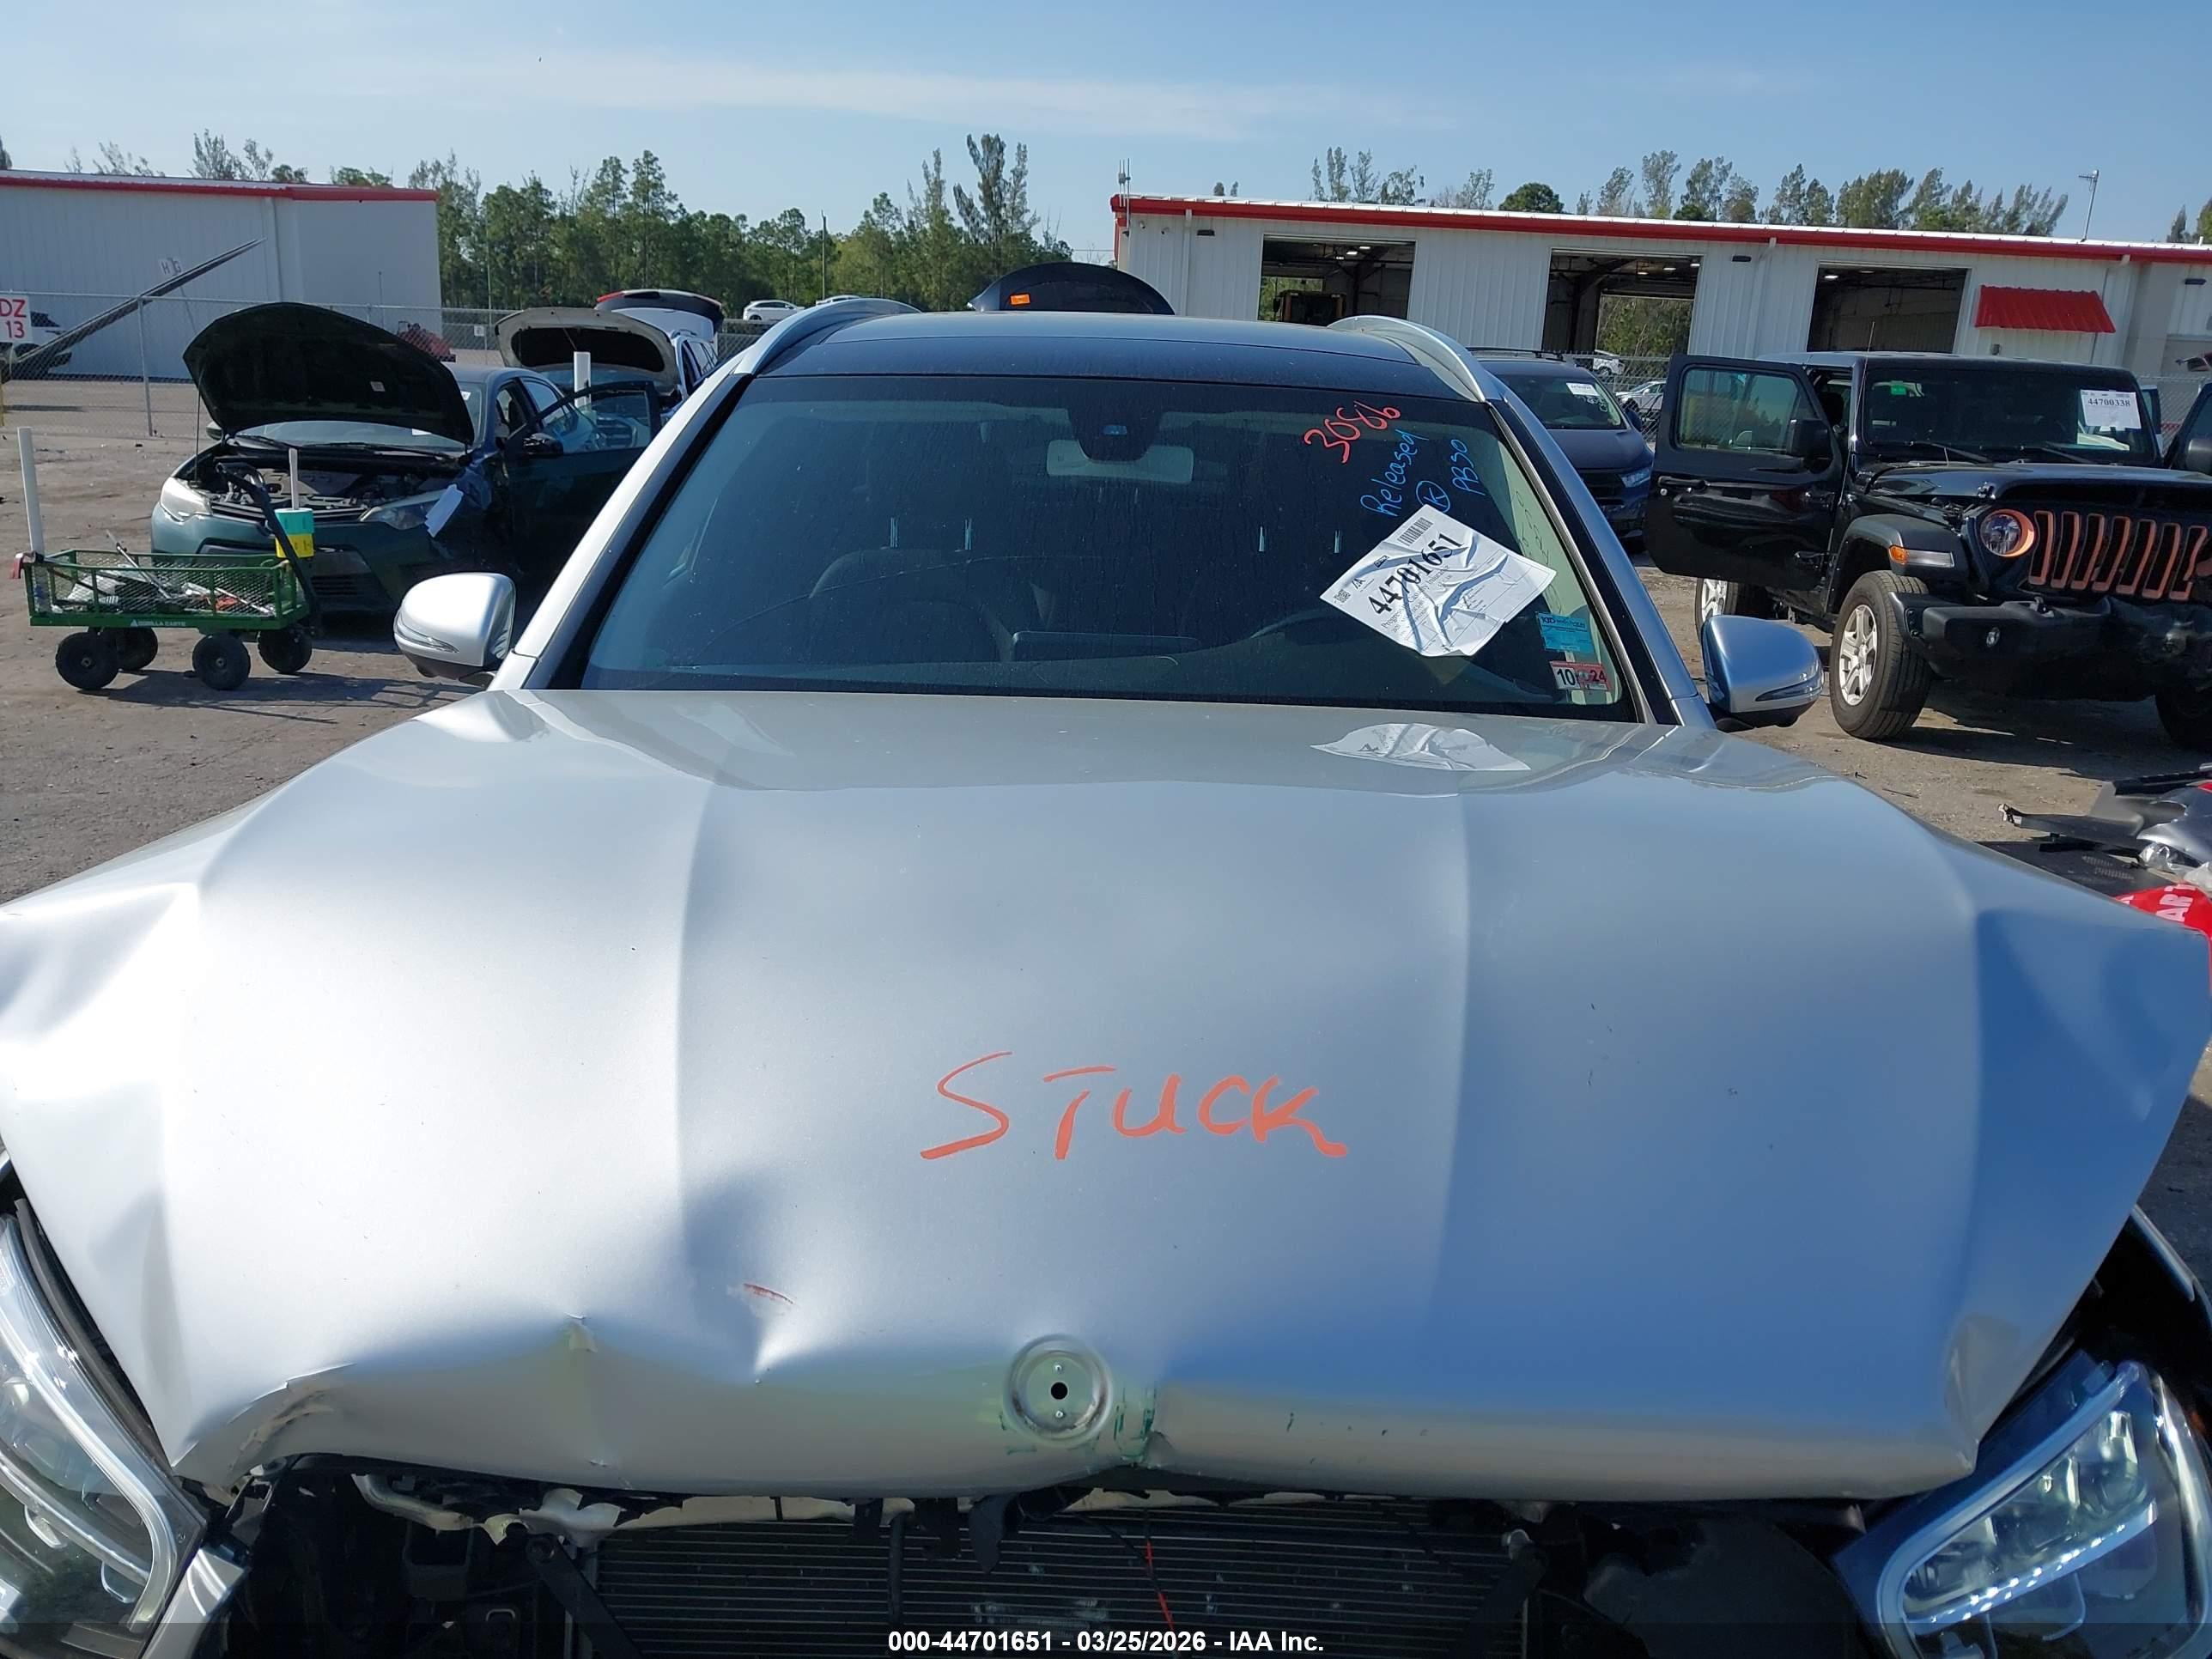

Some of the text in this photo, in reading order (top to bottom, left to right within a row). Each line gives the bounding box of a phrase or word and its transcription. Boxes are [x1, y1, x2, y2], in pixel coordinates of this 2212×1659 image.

[0, 298, 27, 318] DZ
[6, 320, 25, 338] 13
[2087, 398, 2131, 407] 44700338
[1304, 400, 1401, 464] 3086
[1367, 532, 1465, 615] 44701651
[1557, 668, 1576, 686] 10
[1589, 670, 1607, 683] 24
